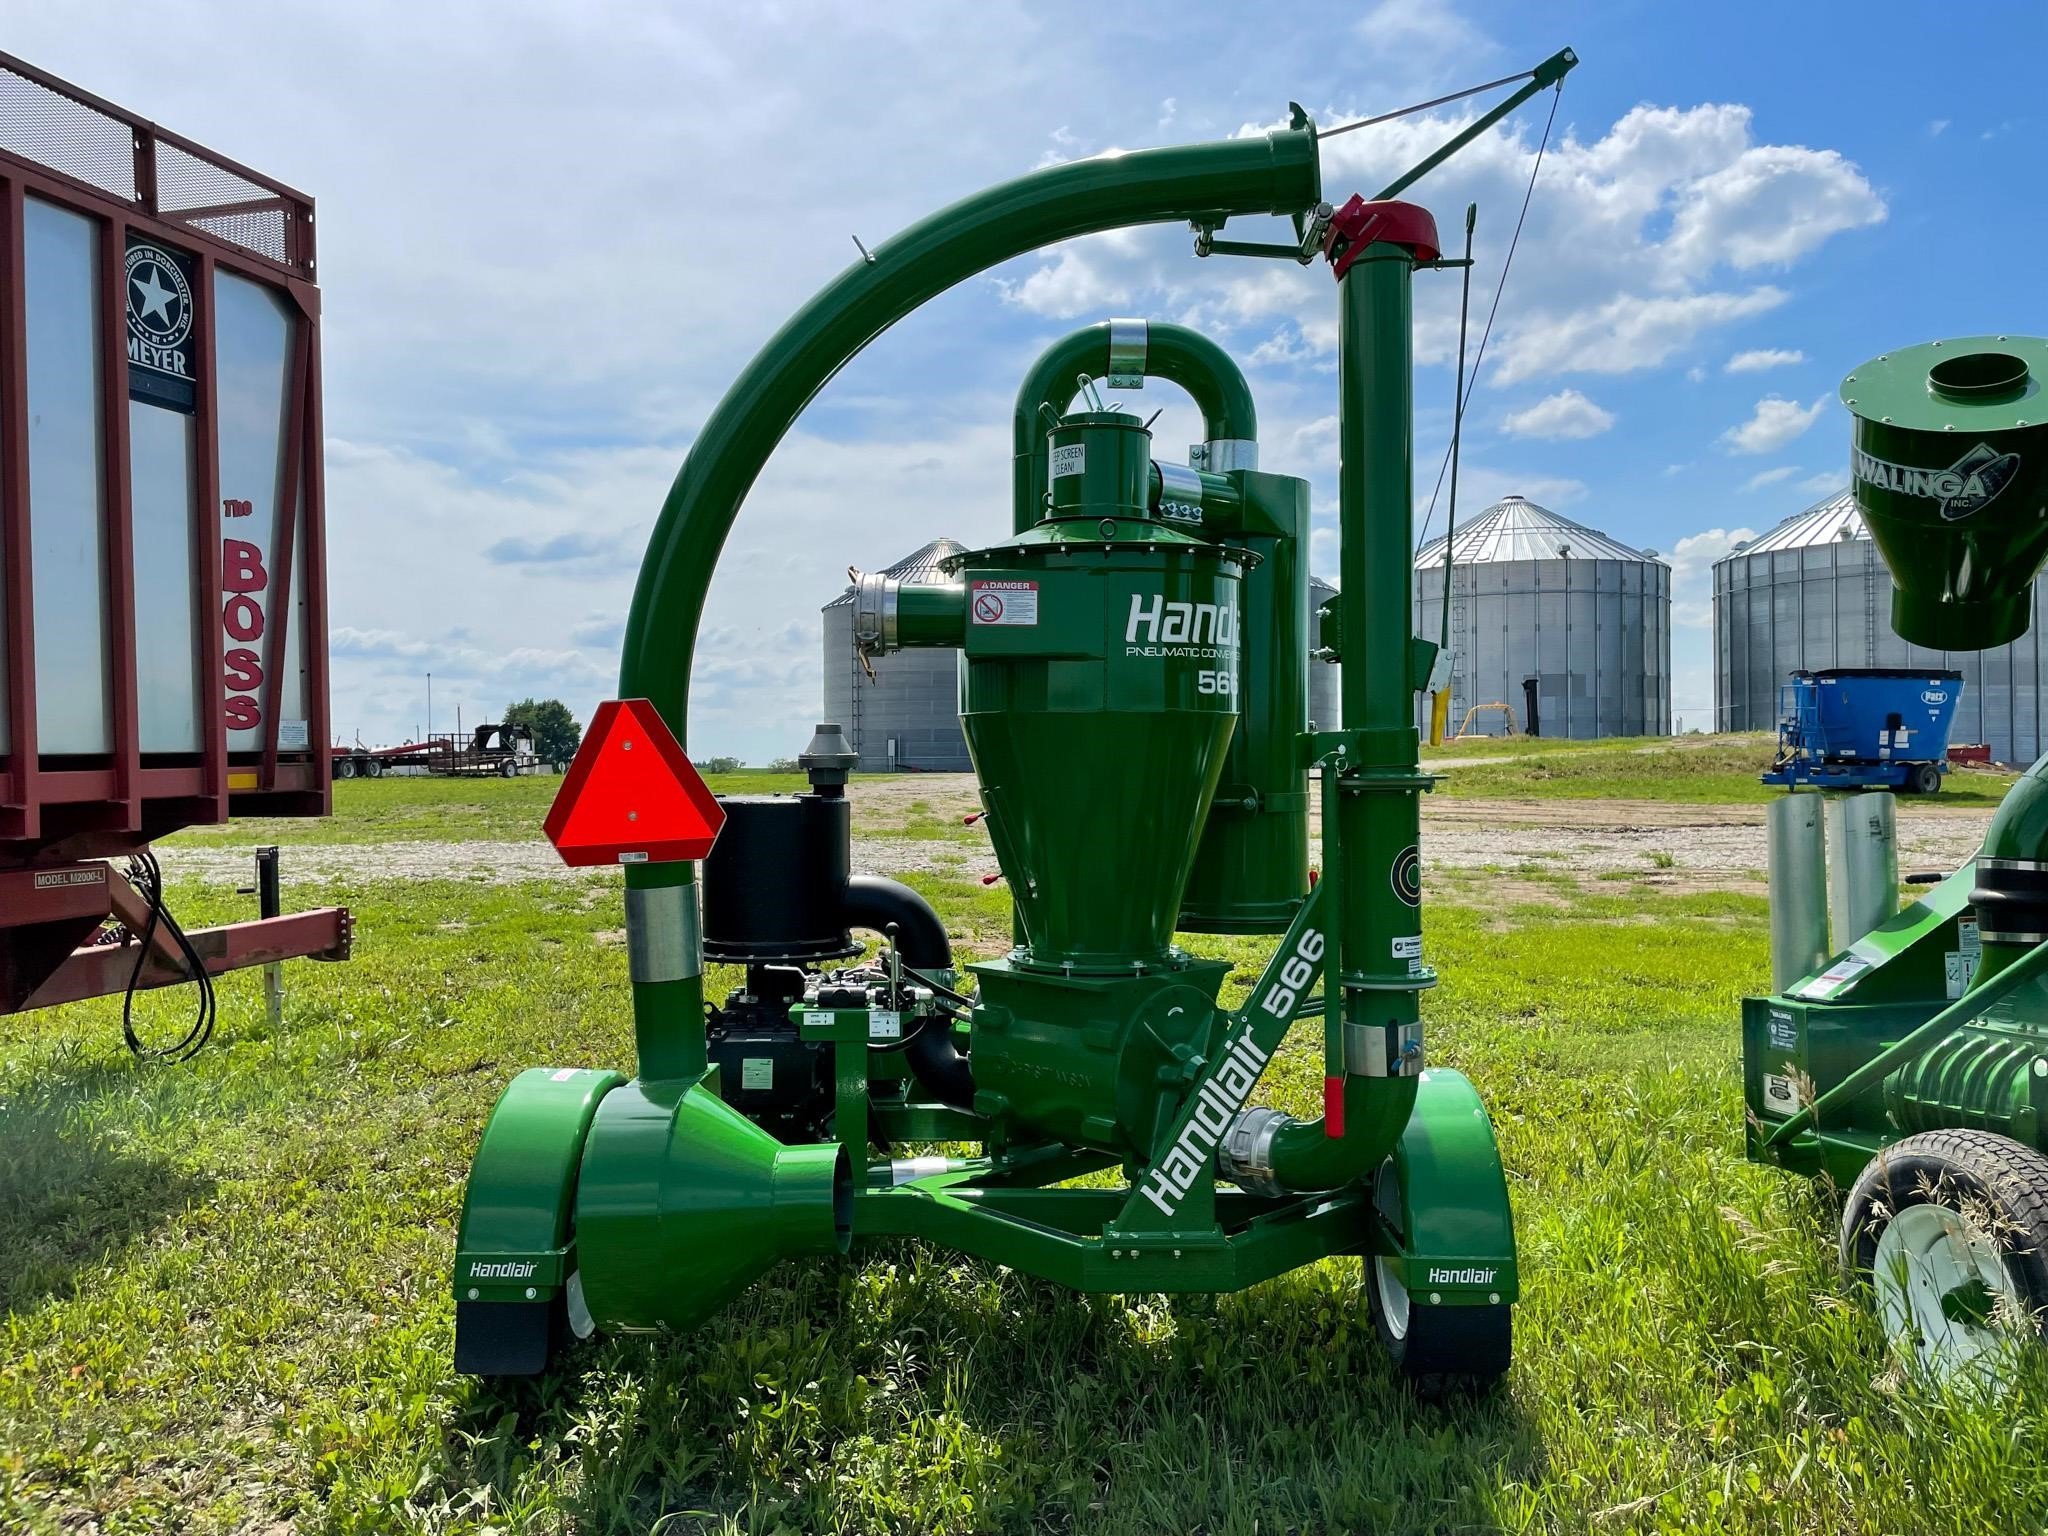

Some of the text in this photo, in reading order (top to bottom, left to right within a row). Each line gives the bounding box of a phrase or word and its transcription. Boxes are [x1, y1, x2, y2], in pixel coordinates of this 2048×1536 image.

[145, 250, 153, 260] IN
[127, 336, 186, 375] MEYER
[1061, 447, 1083, 460] SCREEN
[1858, 452, 1988, 499] WALINGA
[1951, 500, 1972, 508] INC.
[222, 538, 268, 730] BOSS
[1126, 647, 1199, 658] PNEUMATIC
[37, 874, 68, 886] MODEL
[1140, 928, 1324, 1217] Handlair 566
[470, 1261, 537, 1277] Handlair
[1429, 1267, 1497, 1283] Handlair
